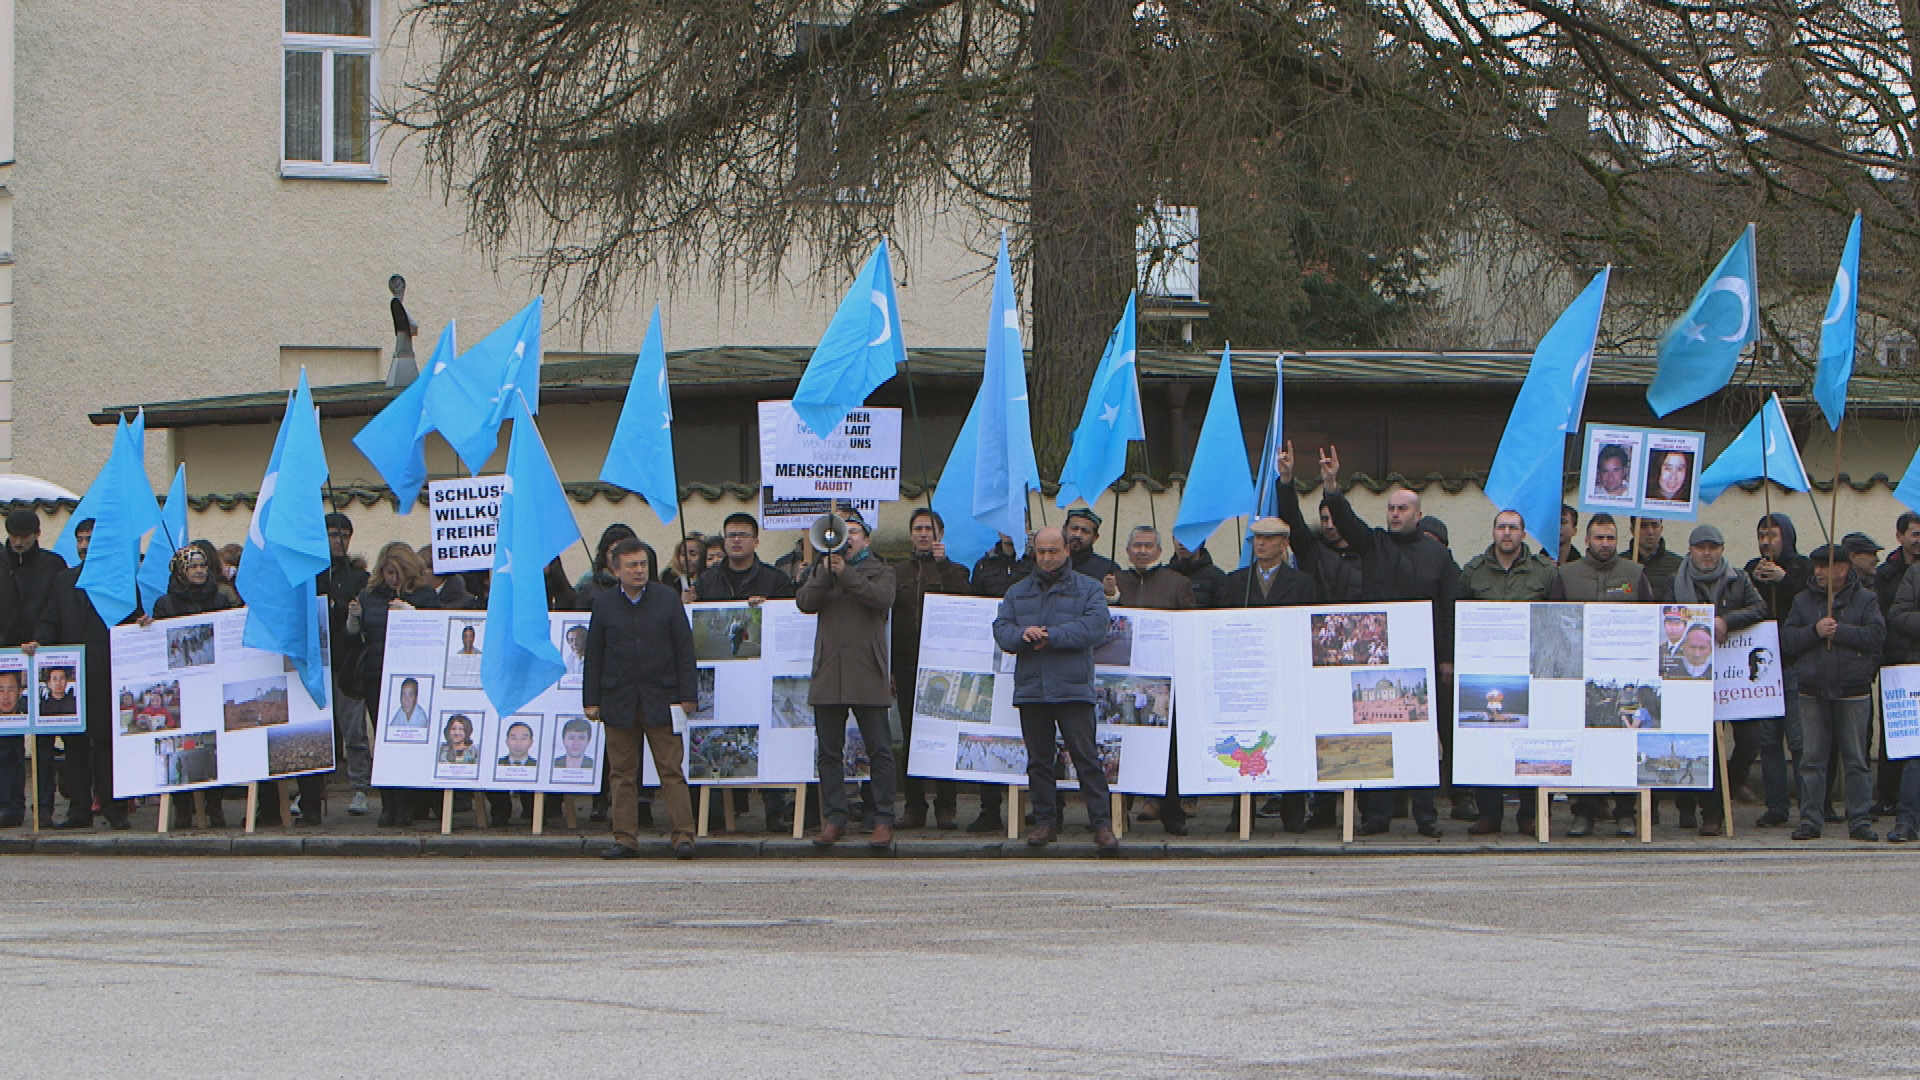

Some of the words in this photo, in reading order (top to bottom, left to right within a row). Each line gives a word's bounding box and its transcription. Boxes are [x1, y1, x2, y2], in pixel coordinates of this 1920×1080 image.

[846, 412, 870, 423] HIER
[845, 426, 871, 435] LAUT
[850, 440, 871, 449] UNS
[776, 464, 897, 479] MENSCHENRECHT
[815, 480, 853, 491] RAUBT!
[435, 502, 501, 521] WILLKÜ
[437, 523, 499, 540] FREIHE
[438, 543, 496, 560] BERAU
[1723, 665, 1744, 679] die
[1884, 689, 1905, 700] WIR
